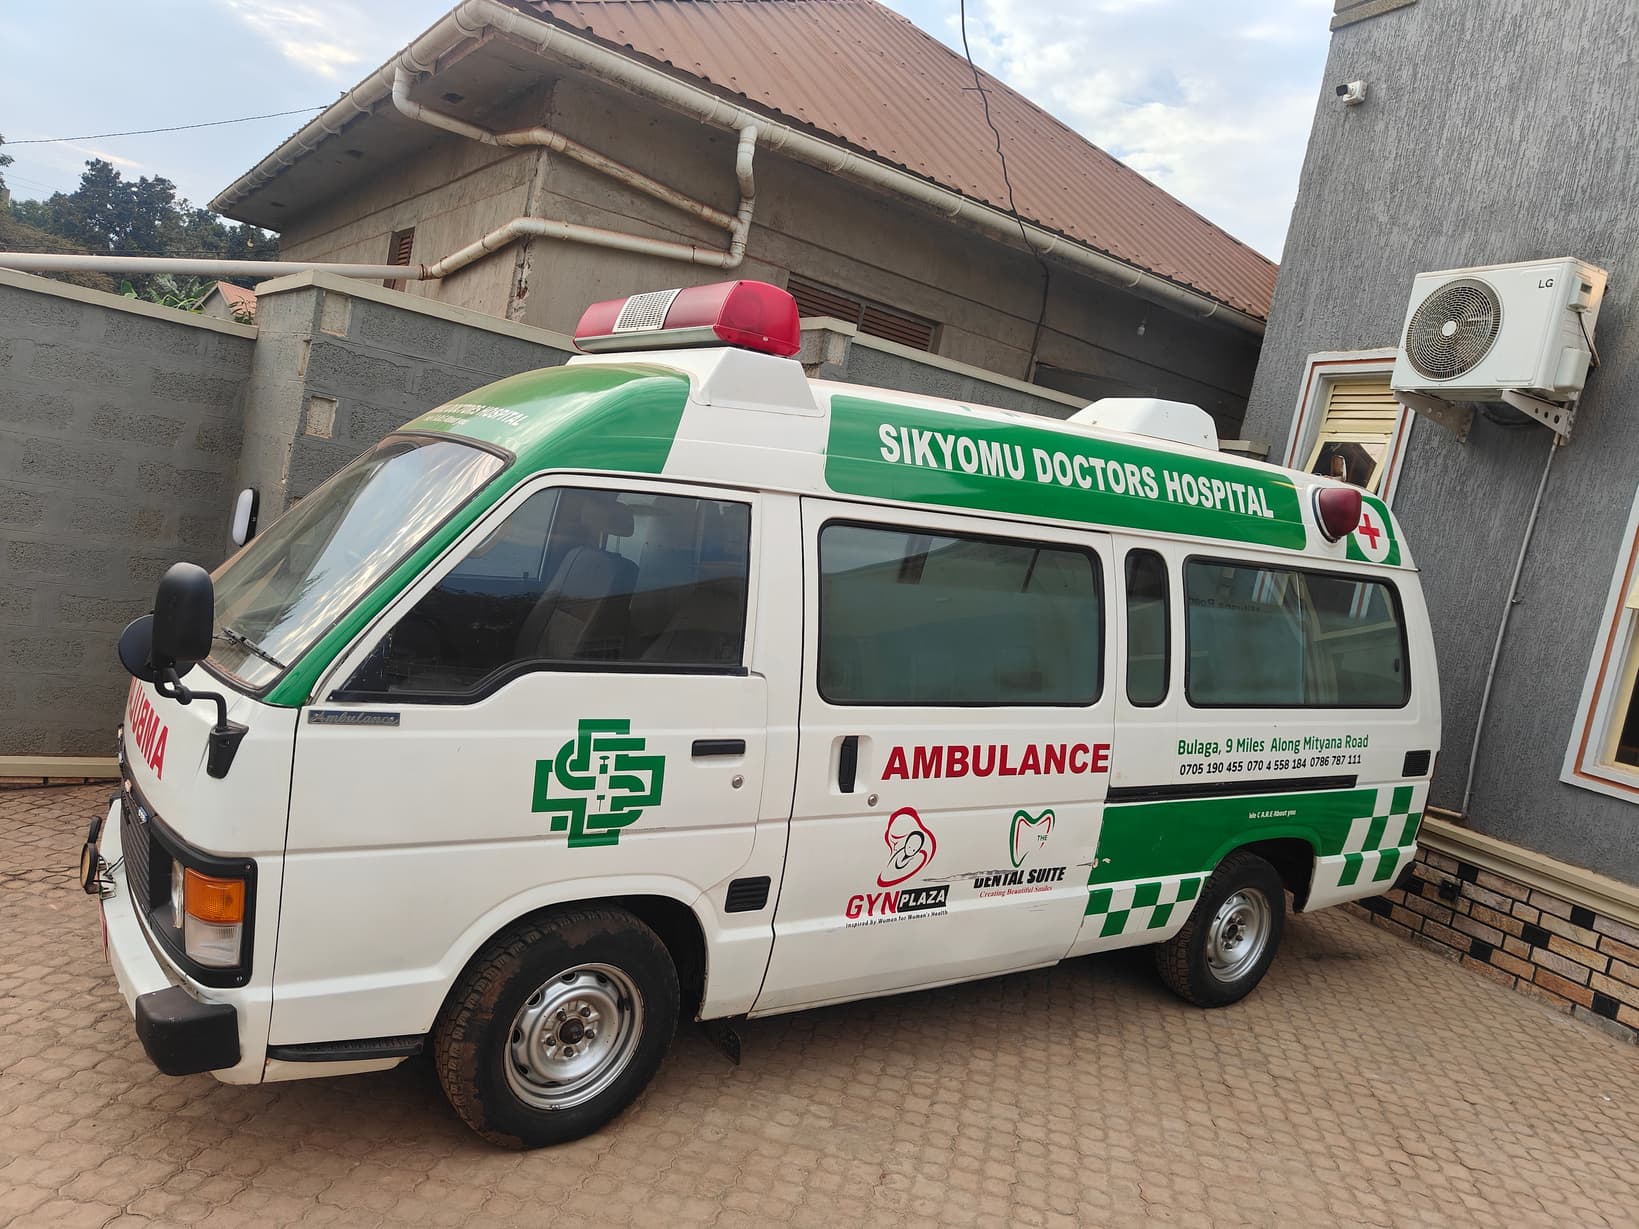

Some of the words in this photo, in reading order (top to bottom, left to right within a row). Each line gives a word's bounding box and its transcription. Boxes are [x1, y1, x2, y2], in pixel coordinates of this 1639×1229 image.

[1538, 279, 1554, 289] LG
[879, 423, 1026, 480] SIKYOMU
[1032, 448, 1159, 499] DOCTORS
[1164, 470, 1275, 519] HOSPITAL
[1178, 739, 1221, 757] Bulaga,
[1226, 738, 1233, 753] 9
[1236, 737, 1265, 752] Miles
[1271, 737, 1300, 754] Along
[1303, 736, 1342, 753] Mityana
[1345, 734, 1369, 749] Road
[881, 743, 1111, 780] AMBULANCE
[1180, 763, 1204, 775] 0705
[1206, 762, 1224, 774] 190
[1226, 761, 1243, 772] 455
[1247, 760, 1263, 771] 070
[1266, 760, 1271, 770] 4
[1274, 759, 1289, 770] 558
[1292, 758, 1306, 769] 184
[1310, 756, 1329, 767] 0786
[1332, 755, 1346, 766] 787
[1347, 754, 1361, 764] 111
[974, 870, 1025, 888] DENTAL
[1027, 866, 1066, 884] SUITE
[979, 888, 1006, 898] Creating
[1006, 886, 1034, 896] Beautiful
[845, 890, 900, 919] GYN
[899, 889, 945, 908] PLAZA
